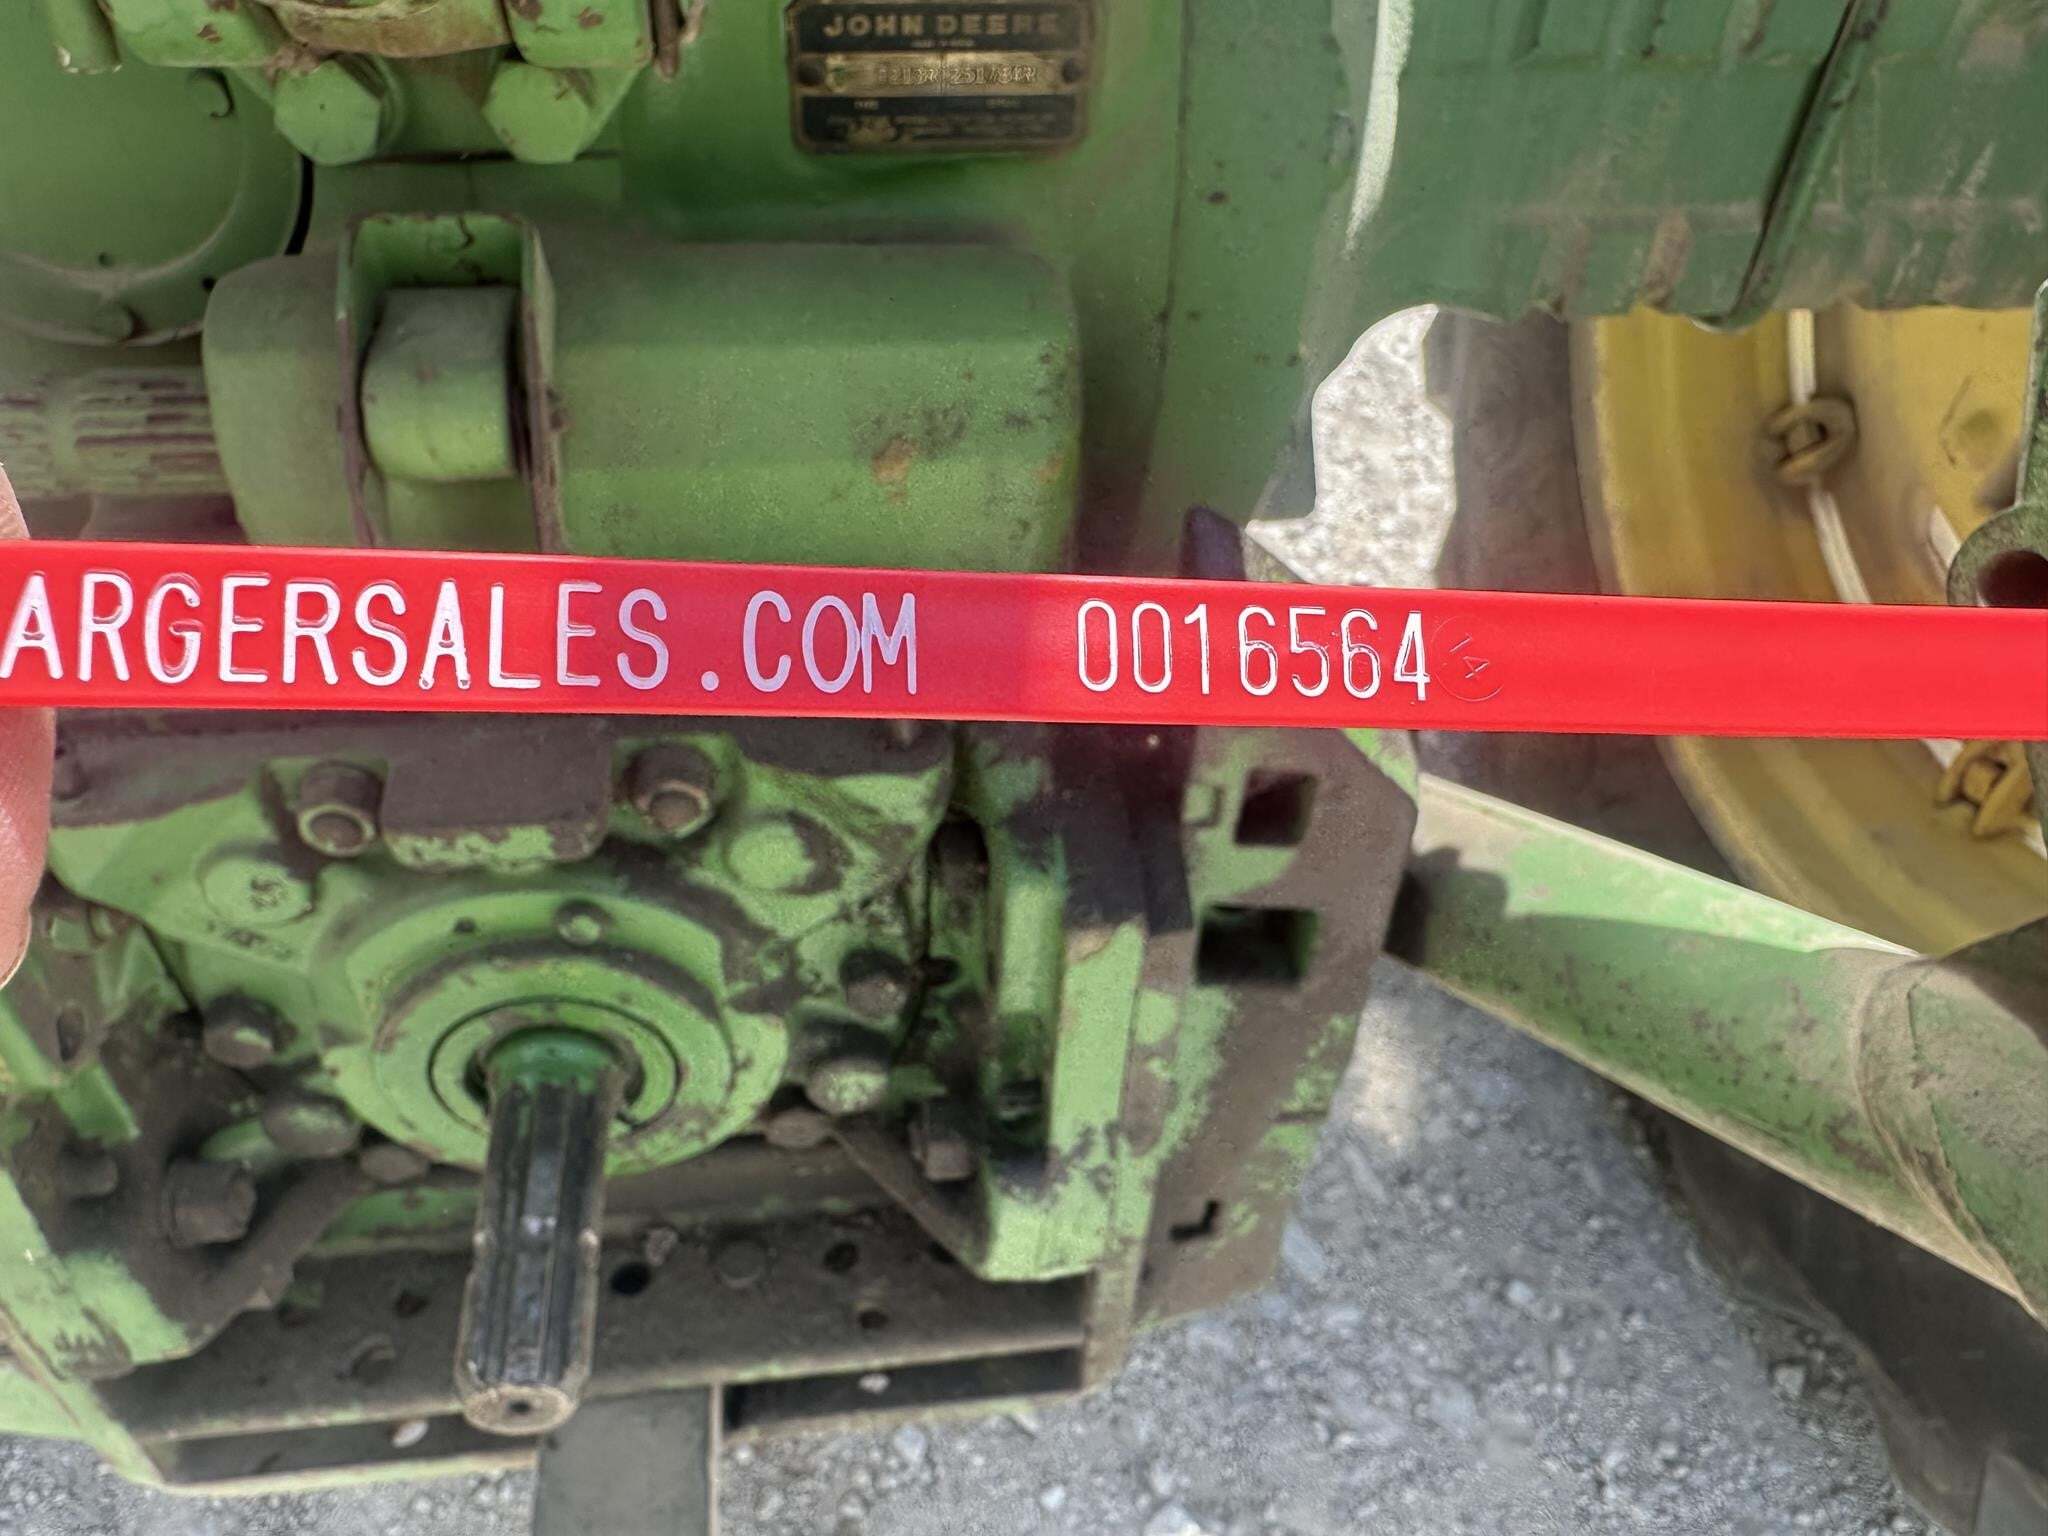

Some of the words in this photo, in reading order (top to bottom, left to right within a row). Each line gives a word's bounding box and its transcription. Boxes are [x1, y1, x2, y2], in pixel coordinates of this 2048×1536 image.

[822, 14, 924, 37] JOHN
[937, 13, 1058, 36] DEERE
[0, 571, 917, 695] ARGERSALES.COM
[1076, 598, 1431, 701] 0016564
